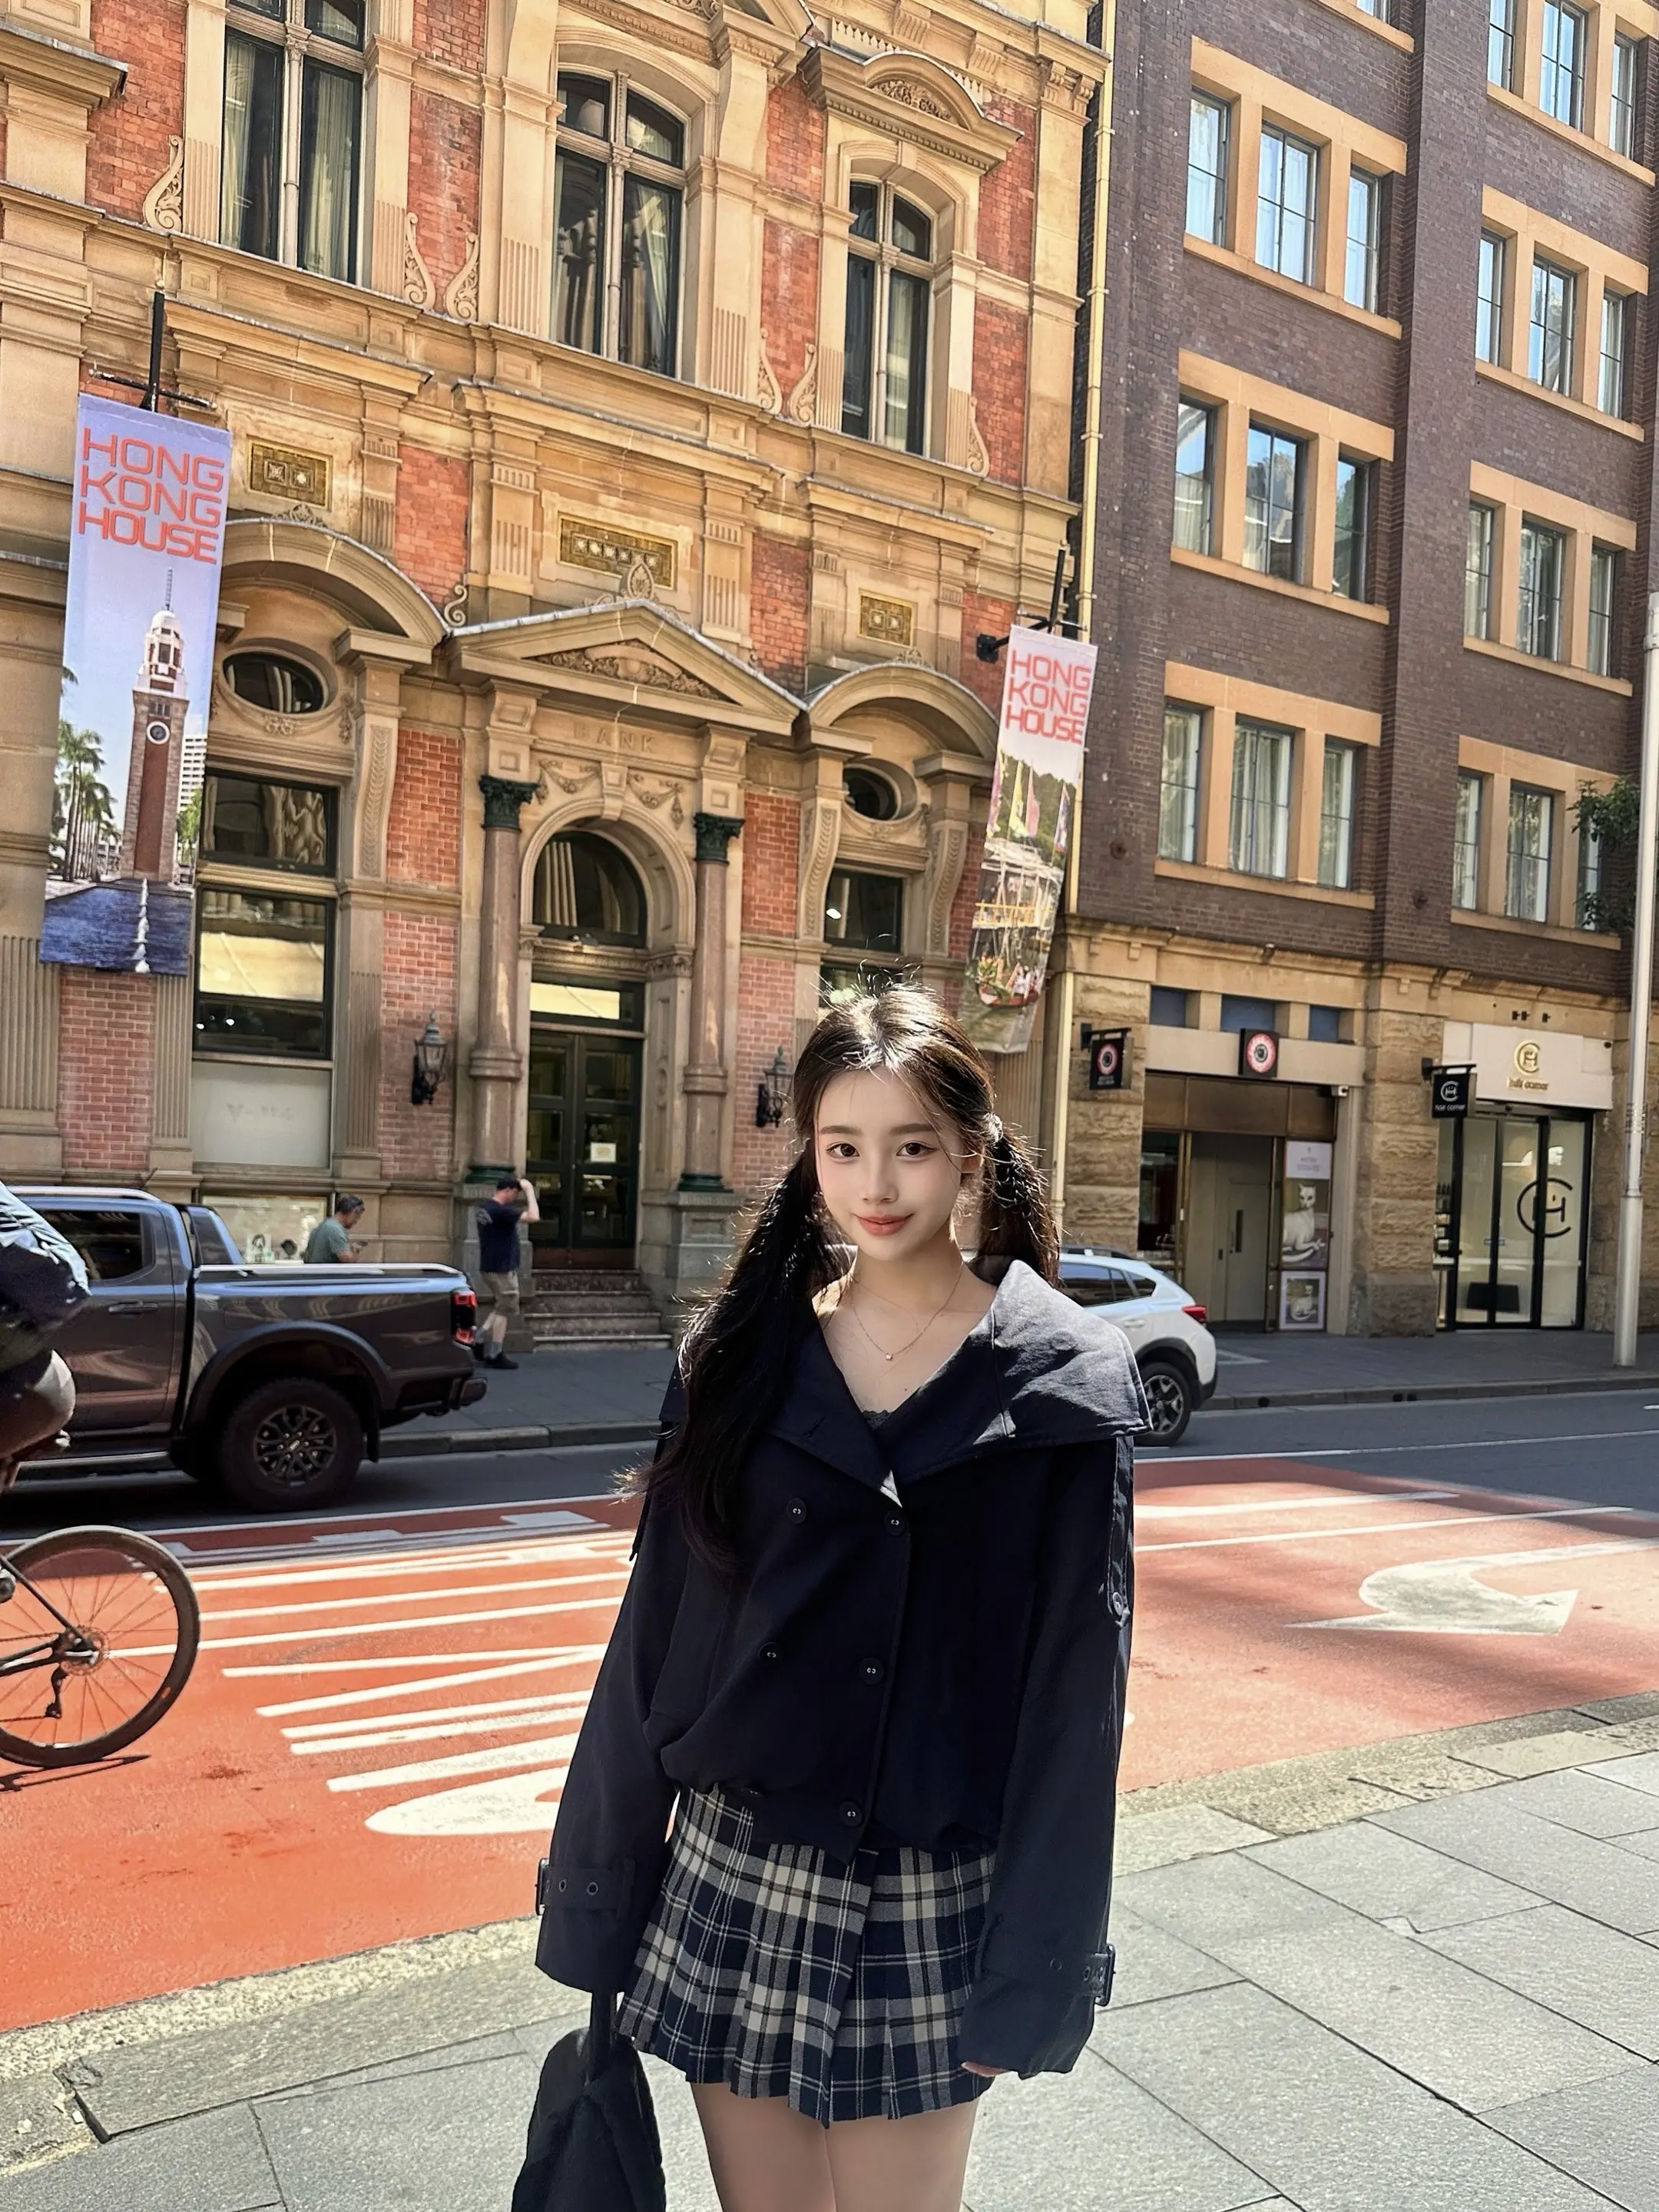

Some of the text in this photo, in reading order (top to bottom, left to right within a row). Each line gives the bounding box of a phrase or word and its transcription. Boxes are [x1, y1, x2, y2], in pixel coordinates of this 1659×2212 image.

[82, 426, 225, 492] HONG
[80, 463, 222, 528] KONG
[78, 501, 219, 565] HOUSE
[1011, 649, 1092, 691] HONG
[1008, 676, 1089, 718] KONG
[572, 723, 654, 753] BANK
[1005, 704, 1084, 745] HOUSE
